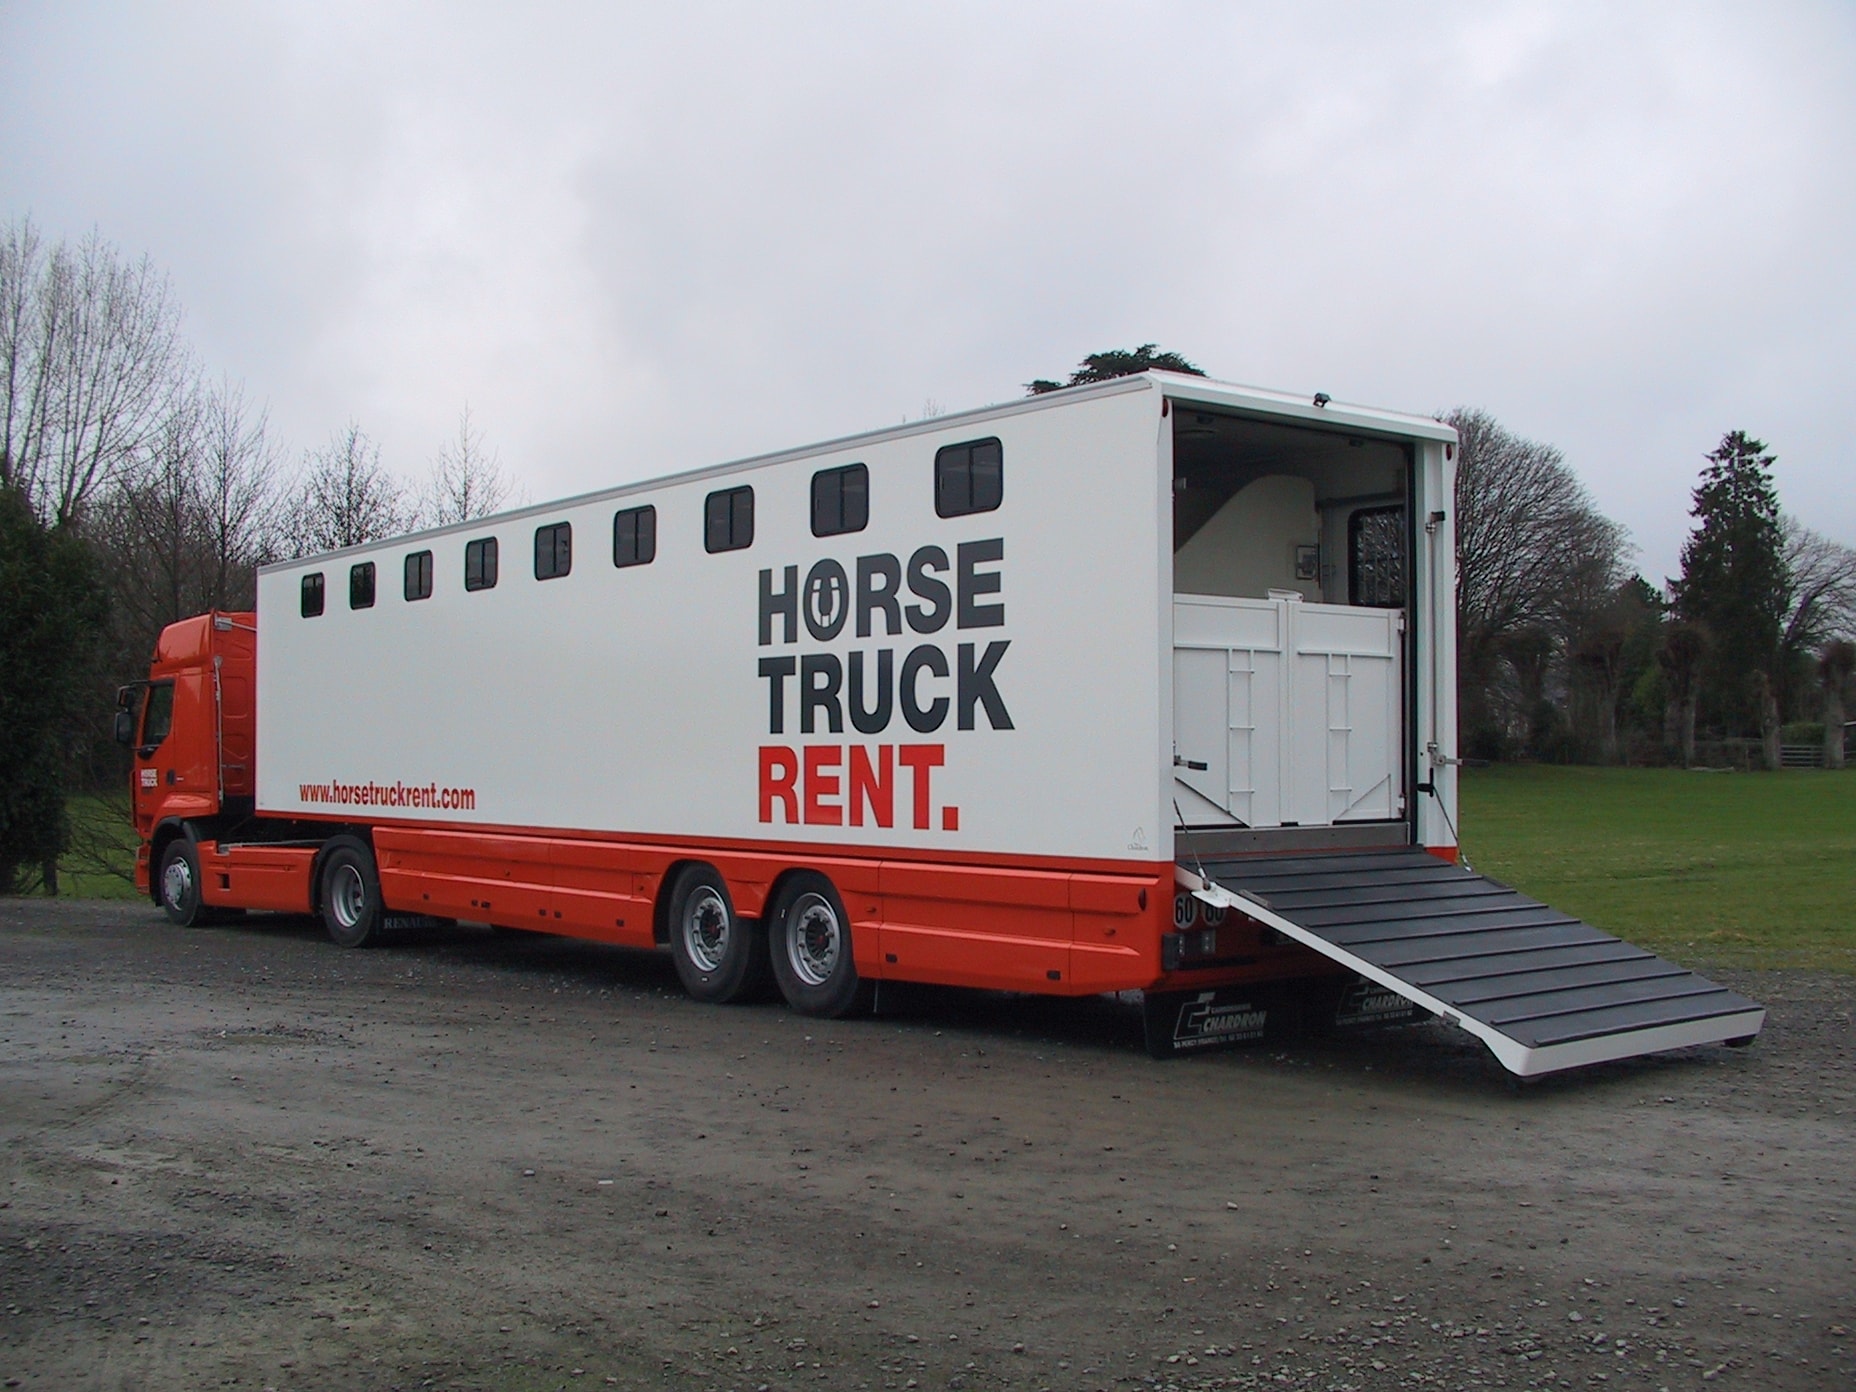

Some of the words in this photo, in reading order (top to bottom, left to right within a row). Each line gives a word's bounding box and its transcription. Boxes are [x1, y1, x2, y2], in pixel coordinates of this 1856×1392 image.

[758, 537, 1005, 646] HORSE
[758, 640, 1015, 734] TRUCK
[299, 779, 476, 810] www.horsetruckrent.com
[758, 744, 959, 831] RENT.
[1175, 897, 1193, 924] 60
[1203, 1010, 1267, 1032] CHARDRON
